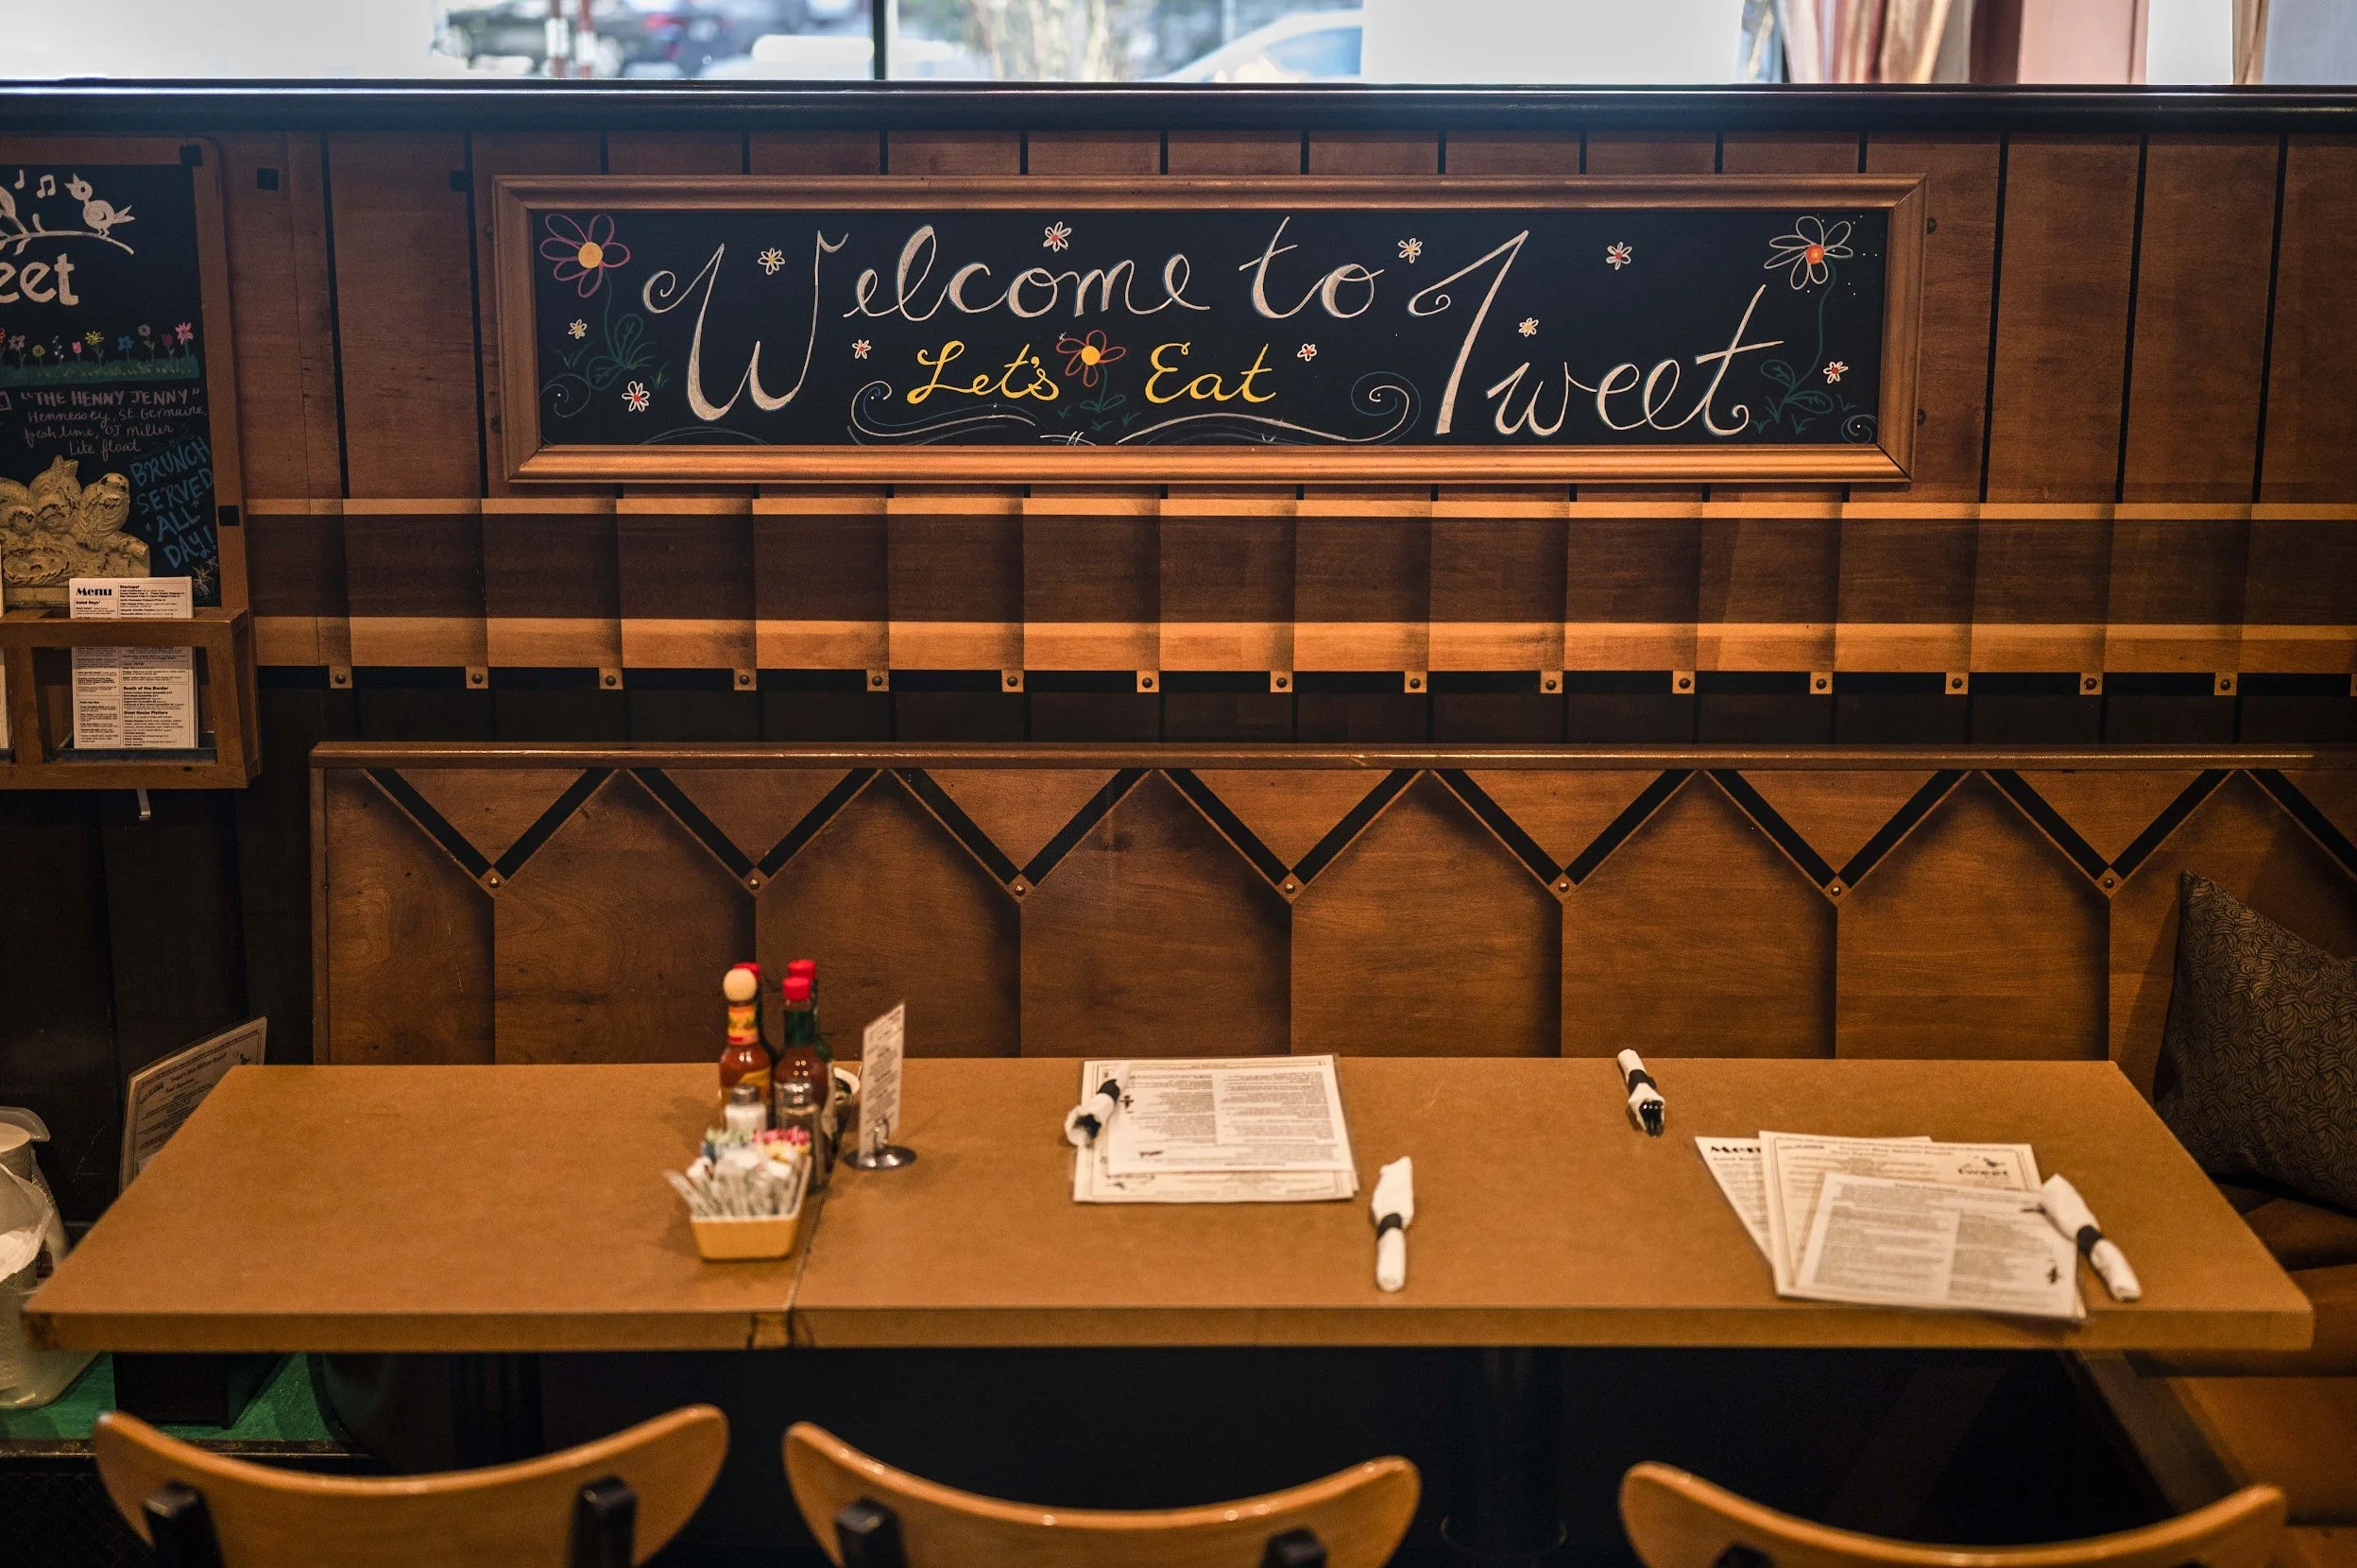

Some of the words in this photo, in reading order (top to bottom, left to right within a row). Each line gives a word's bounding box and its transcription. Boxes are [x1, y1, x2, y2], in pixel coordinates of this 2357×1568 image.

[641, 224, 1210, 421] Welcome
[1238, 215, 1385, 319] to
[1406, 228, 1785, 438] Tweet
[907, 340, 1059, 403] Let's
[1145, 342, 1276, 404] Eat
[71, 390, 125, 407] HENNY
[129, 435, 212, 488] BRUNCH
[136, 467, 214, 515] SERVED
[156, 505, 201, 543] ALL
[76, 587, 112, 596] Menu
